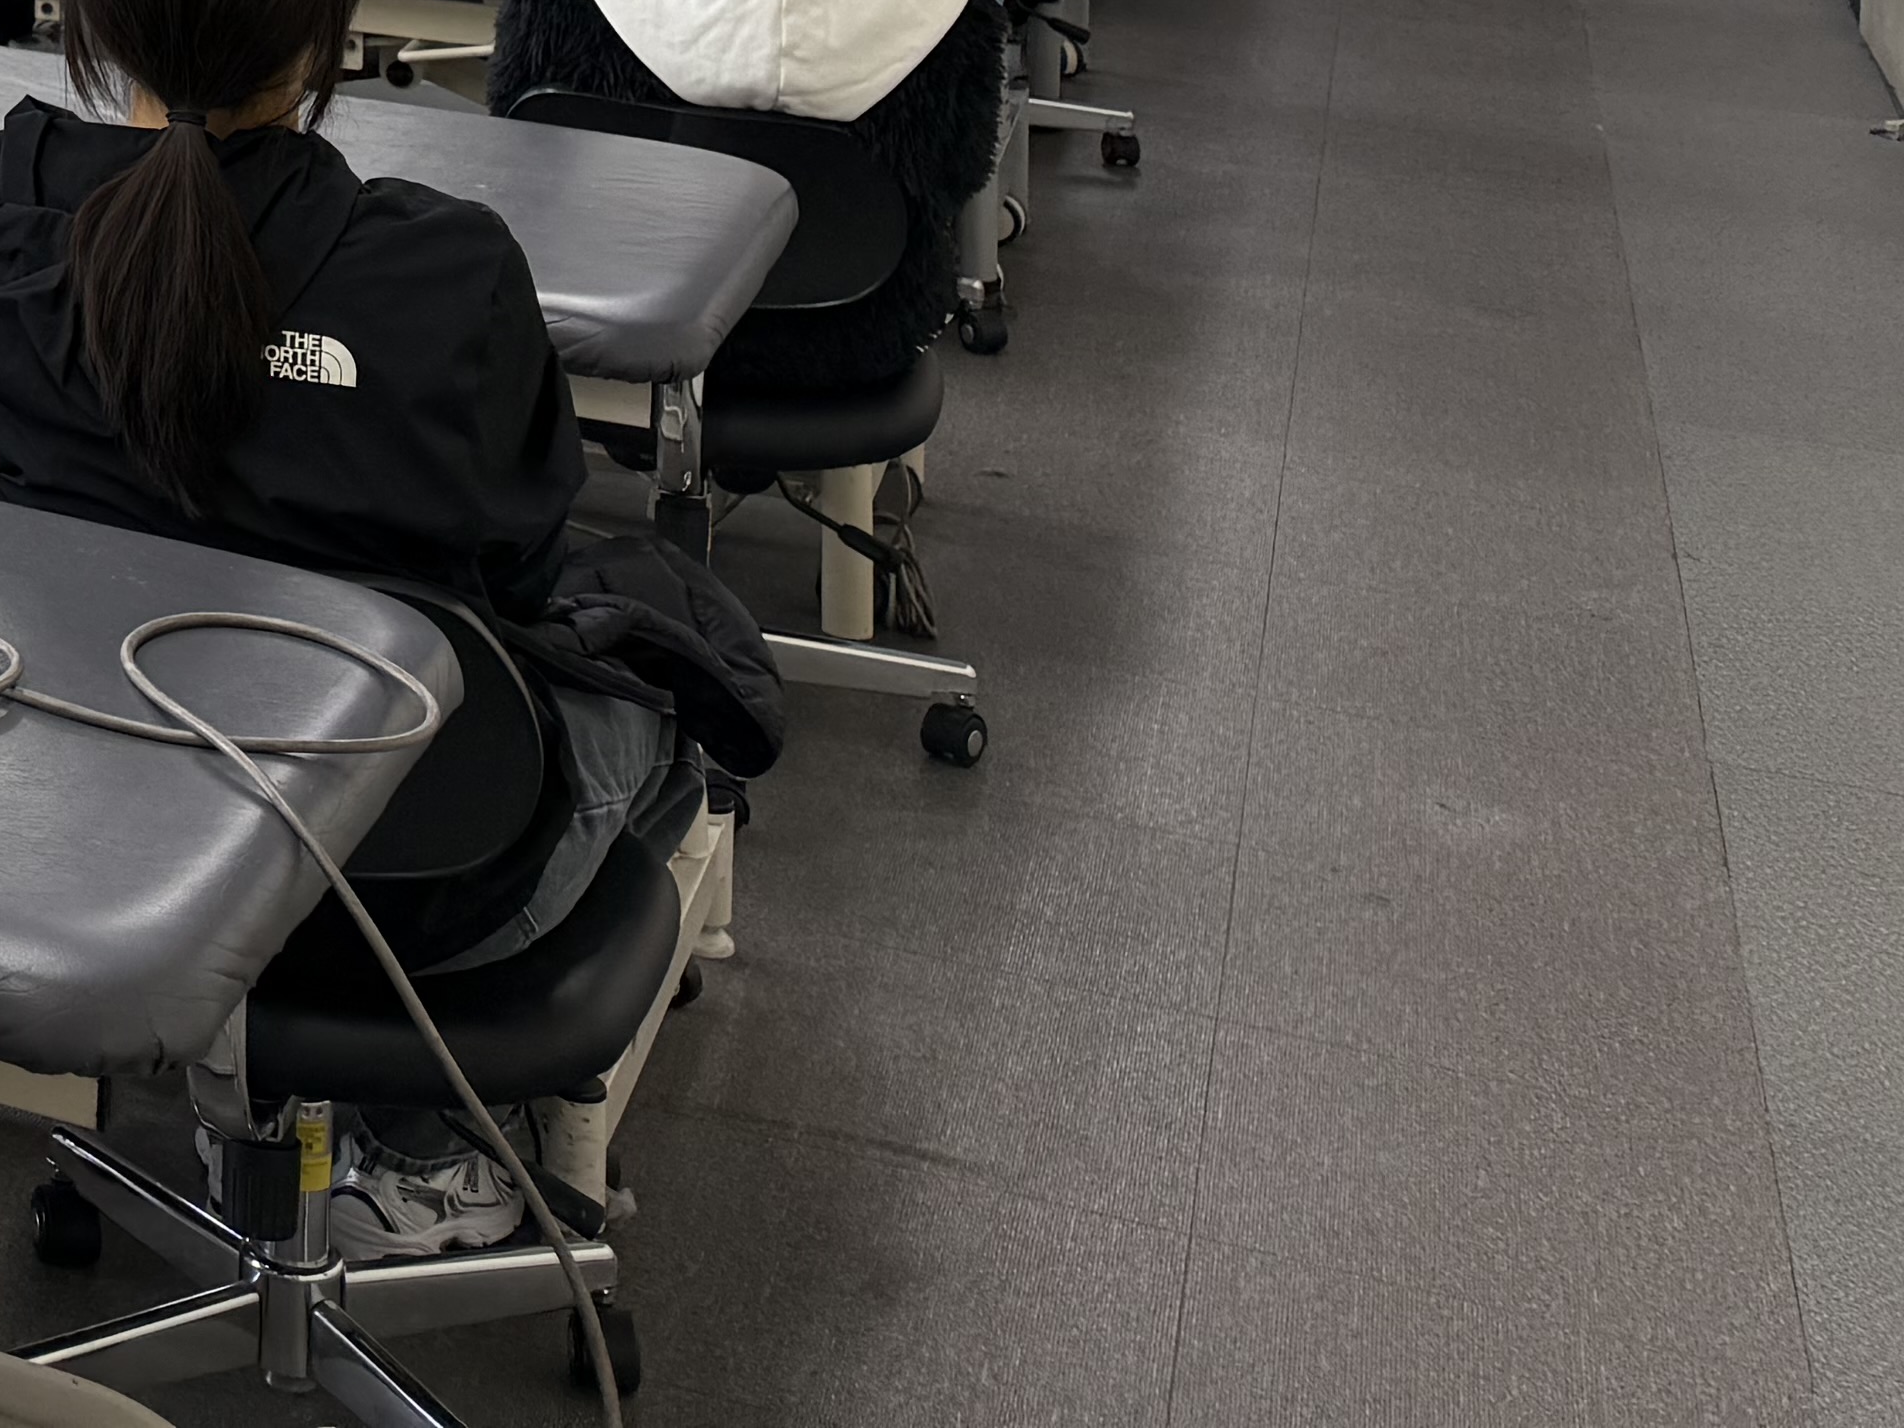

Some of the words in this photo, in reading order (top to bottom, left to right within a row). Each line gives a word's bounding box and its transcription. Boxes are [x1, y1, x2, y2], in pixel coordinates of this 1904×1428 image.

[282, 330, 321, 351] THE
[260, 344, 320, 366] ORTH
[270, 362, 319, 383] FACE
